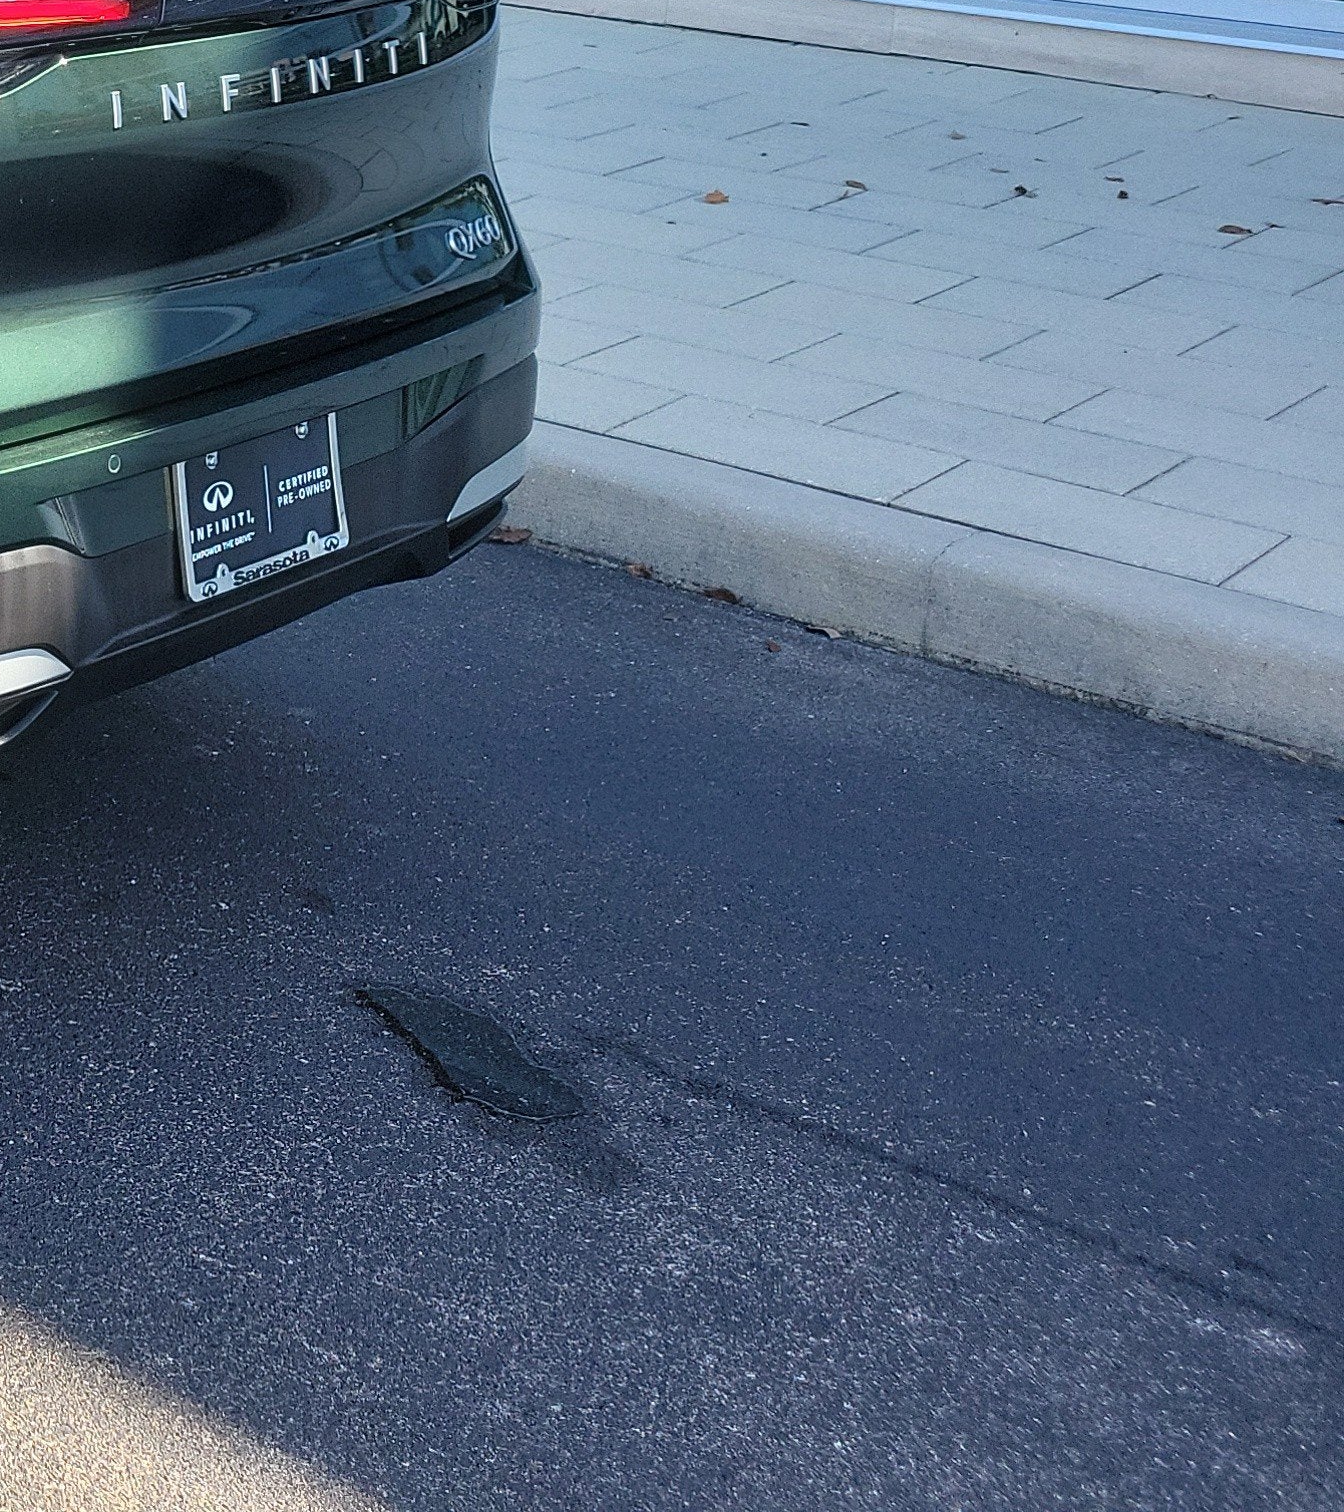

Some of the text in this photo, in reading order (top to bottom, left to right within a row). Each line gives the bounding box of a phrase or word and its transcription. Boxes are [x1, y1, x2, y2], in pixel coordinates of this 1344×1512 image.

[111, 31, 428, 129] INFINITI
[447, 214, 501, 260] QX60
[276, 478, 331, 508] PRE-OWNED
[278, 465, 329, 492] CERTIFIED
[190, 509, 253, 544] INFINITI
[232, 549, 310, 586] Sarasota
